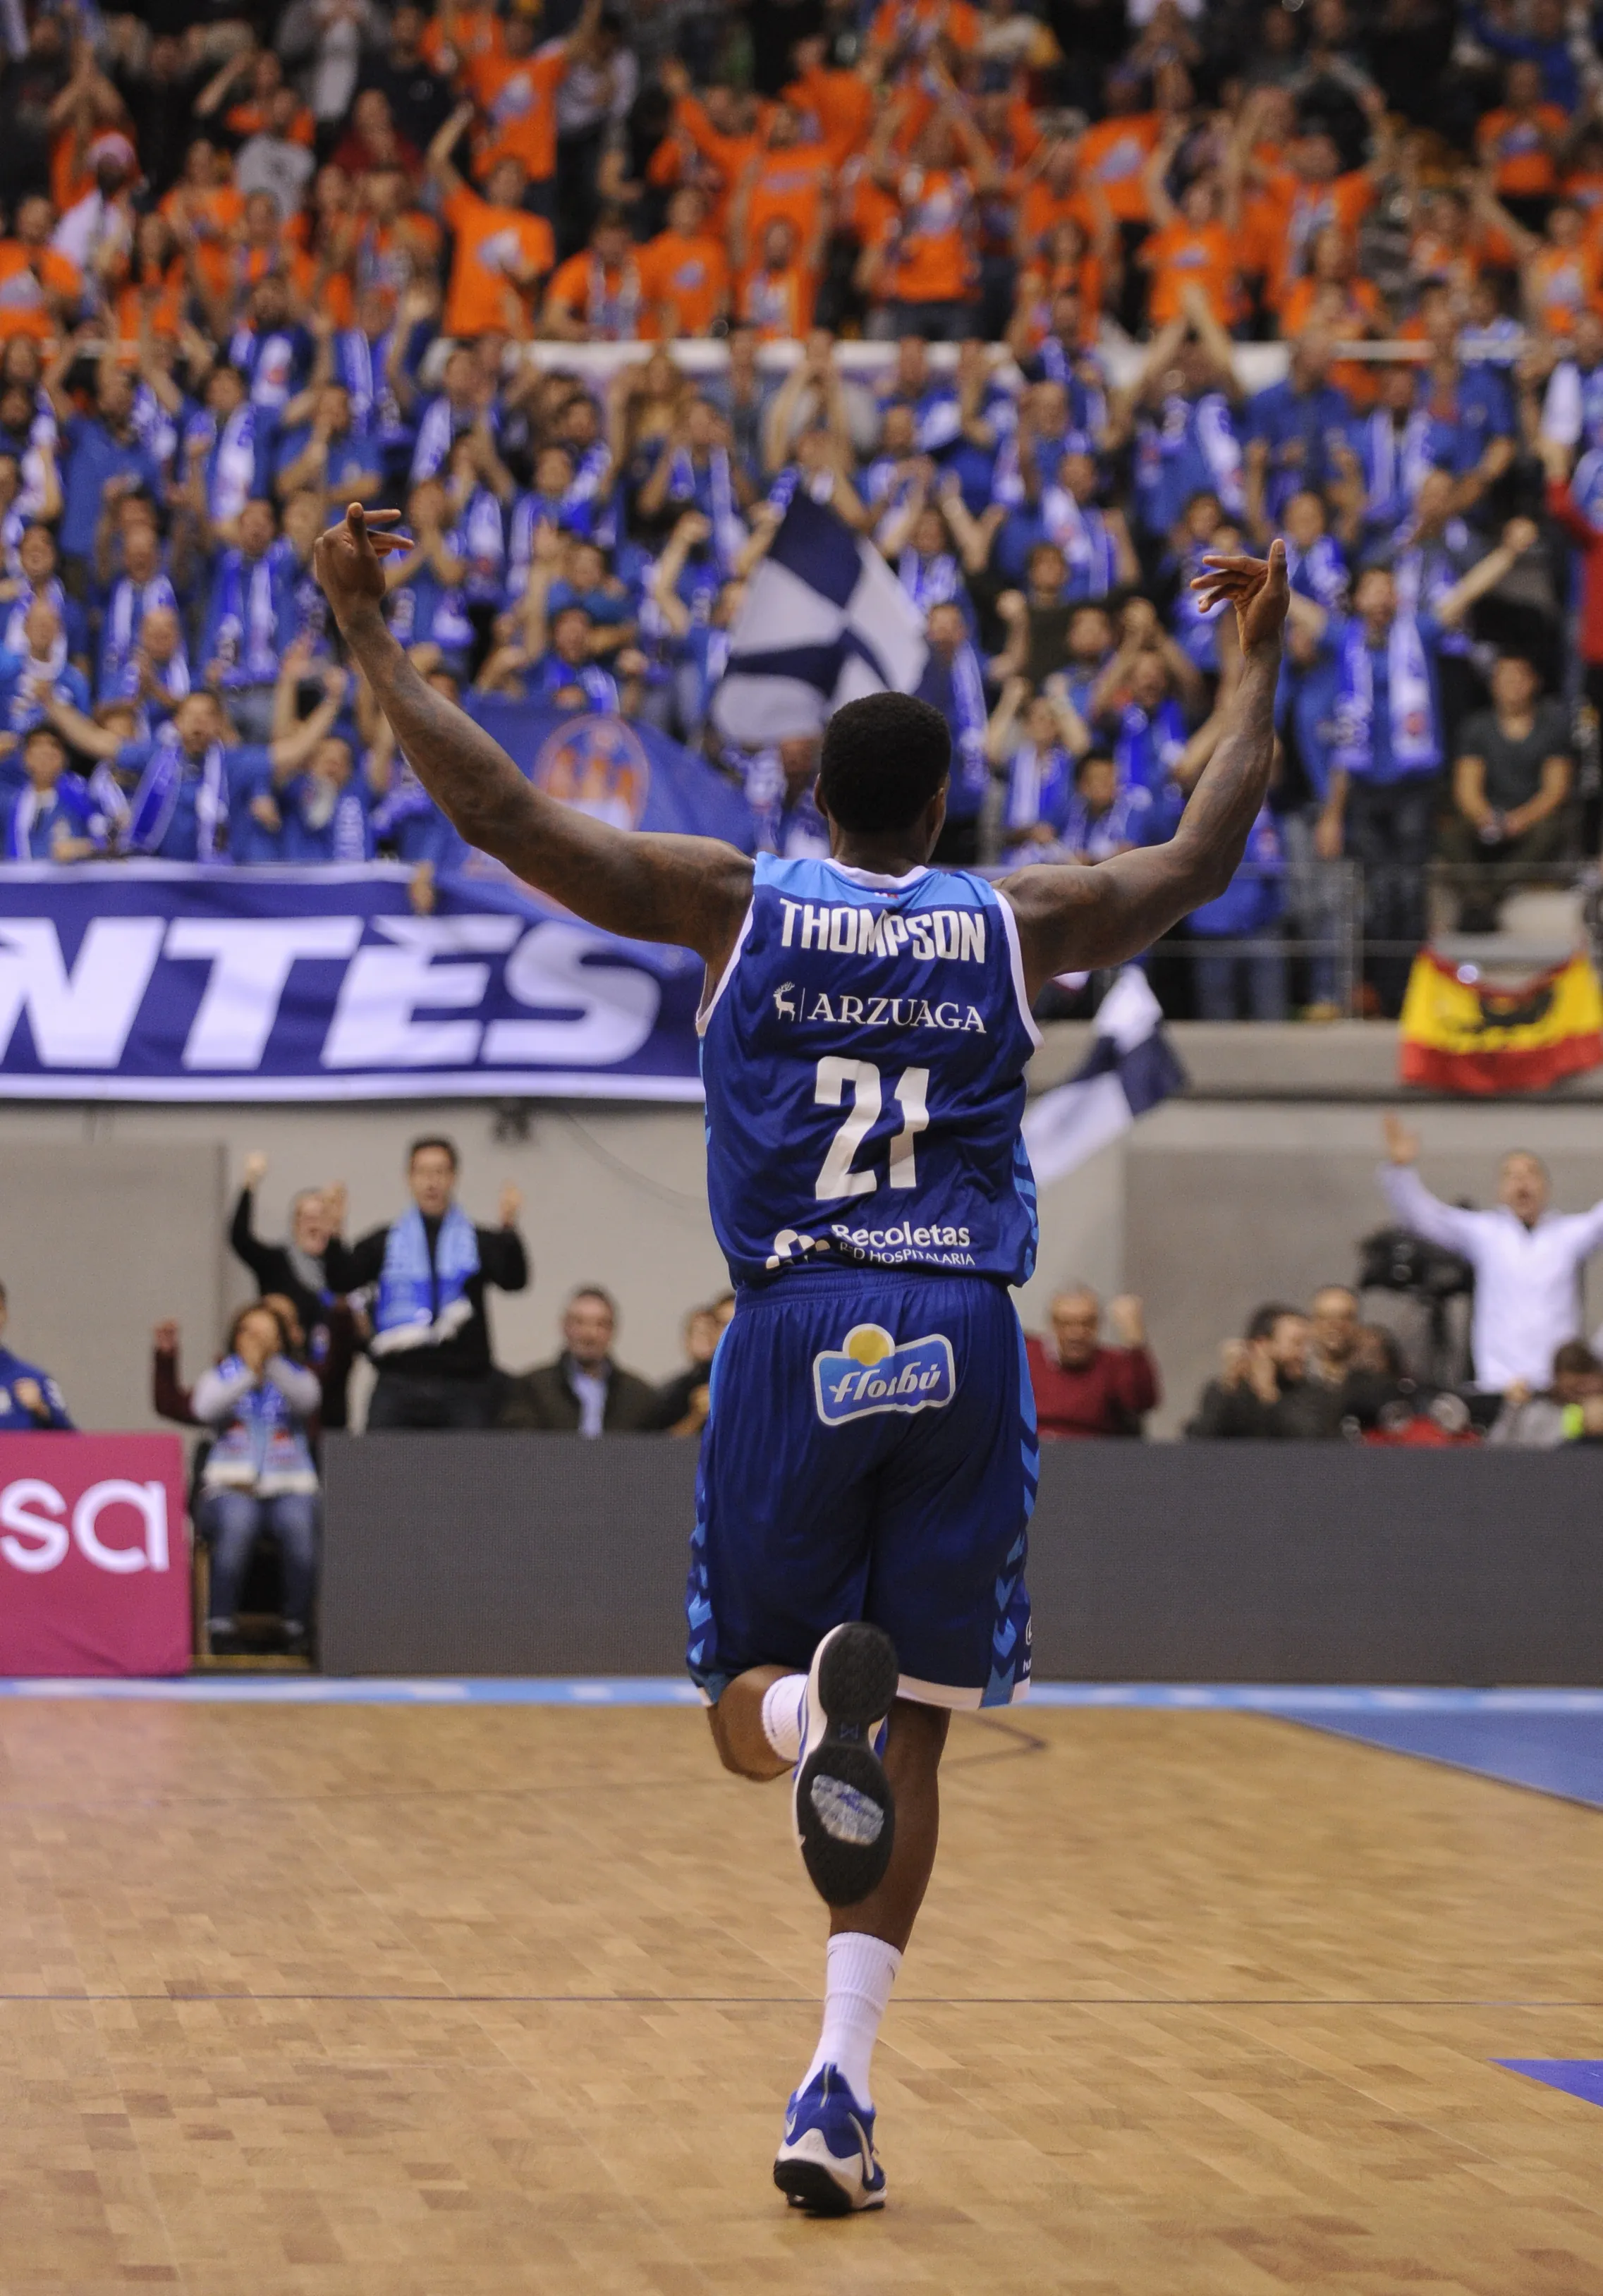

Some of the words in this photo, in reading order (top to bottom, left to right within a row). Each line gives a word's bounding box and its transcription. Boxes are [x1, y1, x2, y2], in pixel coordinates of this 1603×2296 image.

[779, 898, 986, 964] THOMPSON
[807, 992, 987, 1034] ARZUAGA
[815, 1056, 930, 1201] 21
[831, 1221, 970, 1248] Recoletas
[870, 1248, 976, 1266] HOSPITALARIA
[0, 1477, 170, 1573] sa
